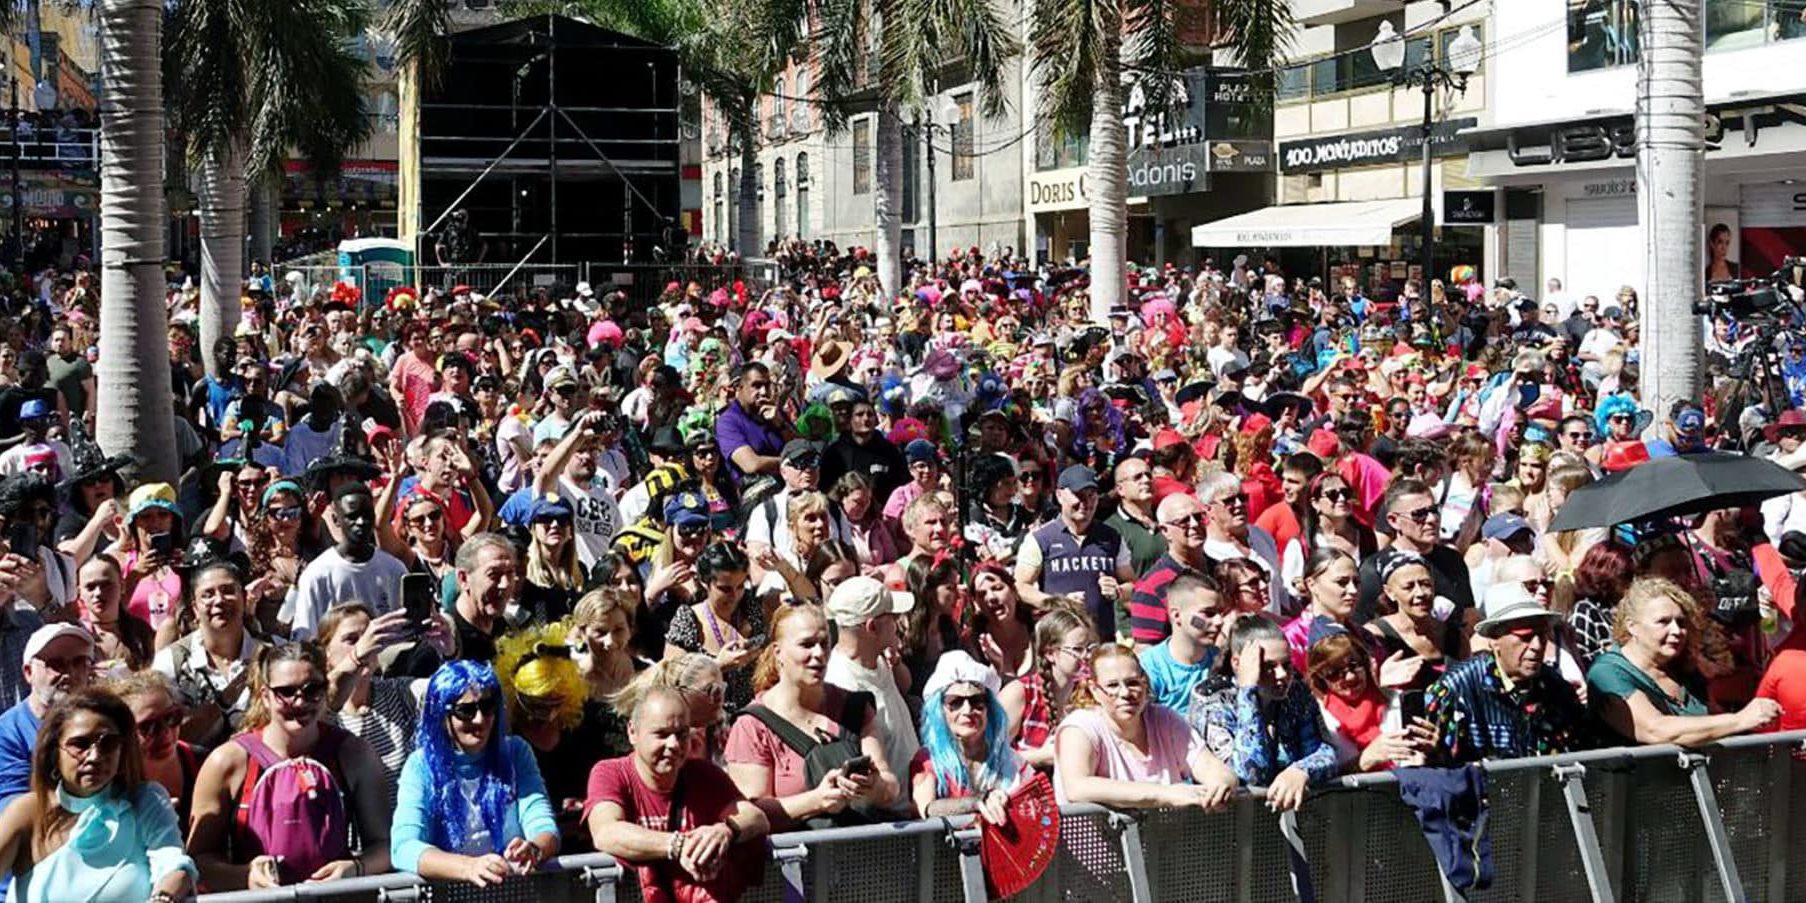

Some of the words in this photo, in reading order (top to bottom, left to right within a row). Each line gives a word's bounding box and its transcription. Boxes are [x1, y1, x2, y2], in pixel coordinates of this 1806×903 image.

[1244, 156, 1266, 165] PLAZA
[1286, 146, 1312, 166] 100
[1313, 136, 1399, 164] MONTADITOS
[1031, 180, 1075, 205] DORIS
[1051, 556, 1114, 572] HACKETT
